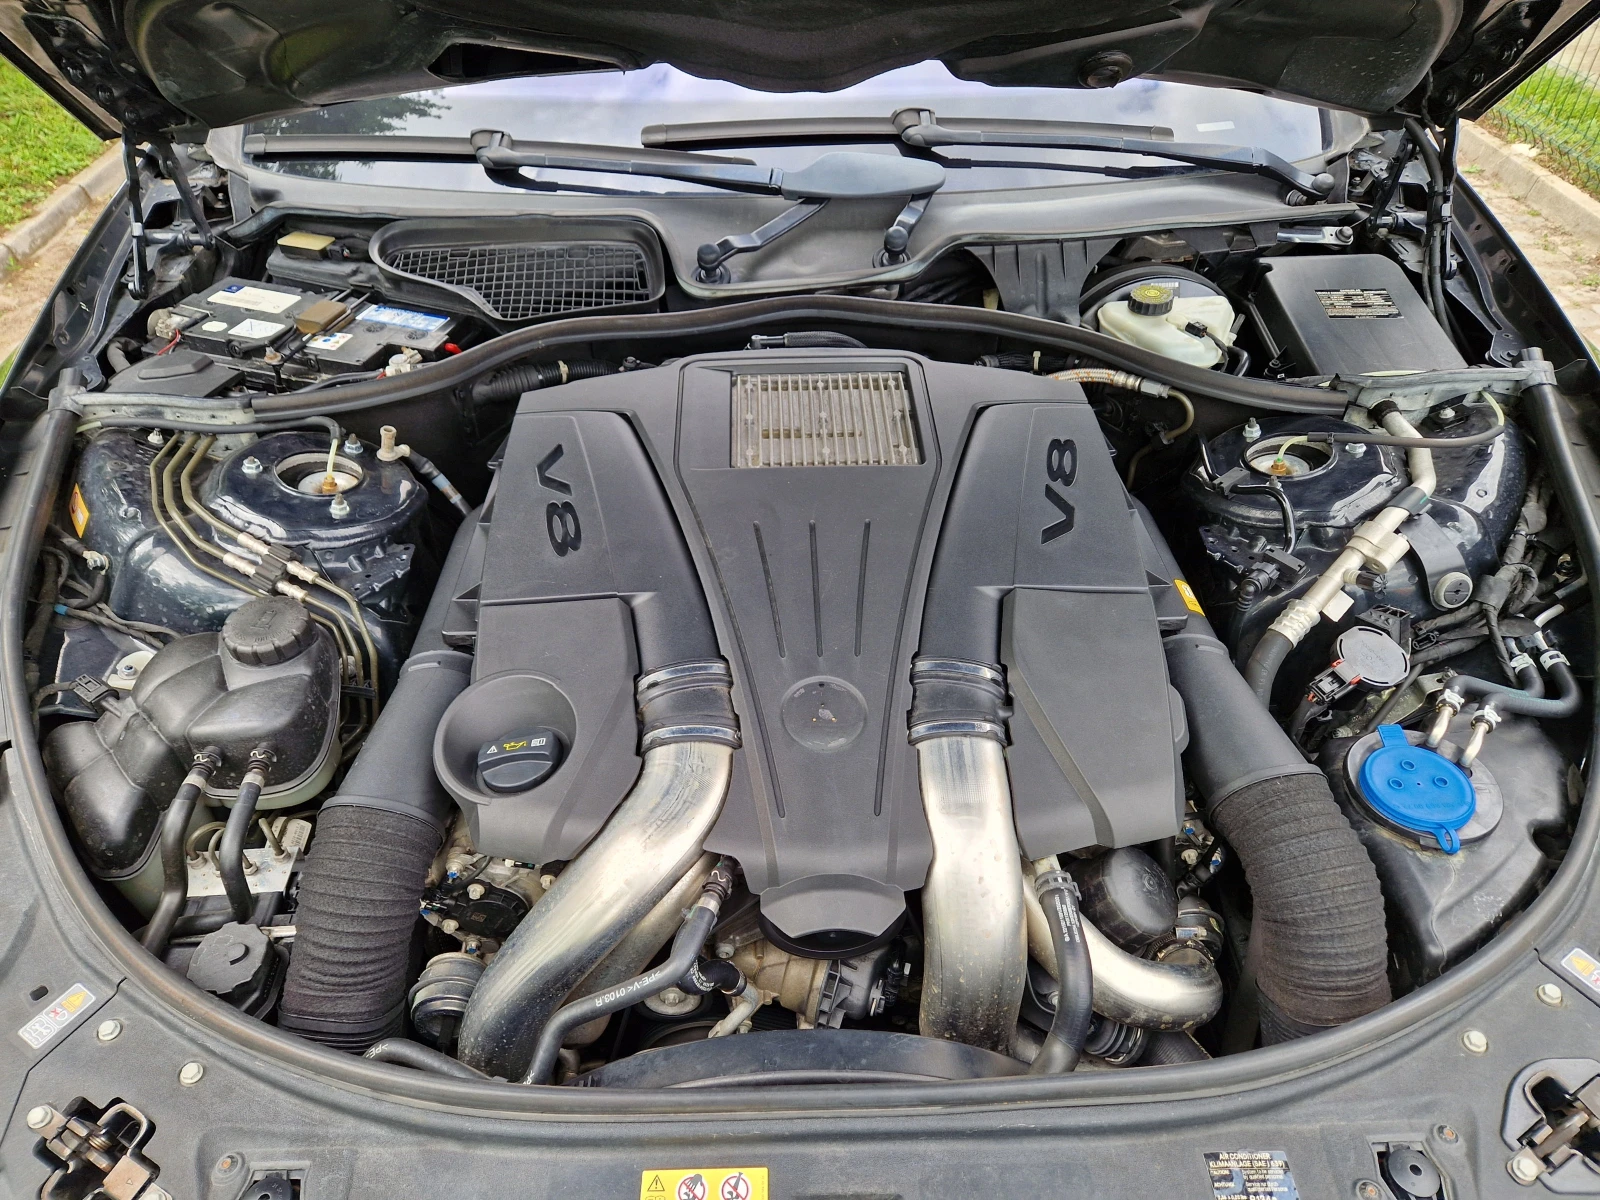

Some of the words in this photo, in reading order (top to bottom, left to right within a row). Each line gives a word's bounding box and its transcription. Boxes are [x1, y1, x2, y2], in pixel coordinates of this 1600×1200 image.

[536, 443, 582, 557] V8
[1041, 438, 1078, 545] V8
[595, 987, 626, 1007] 0103.R
